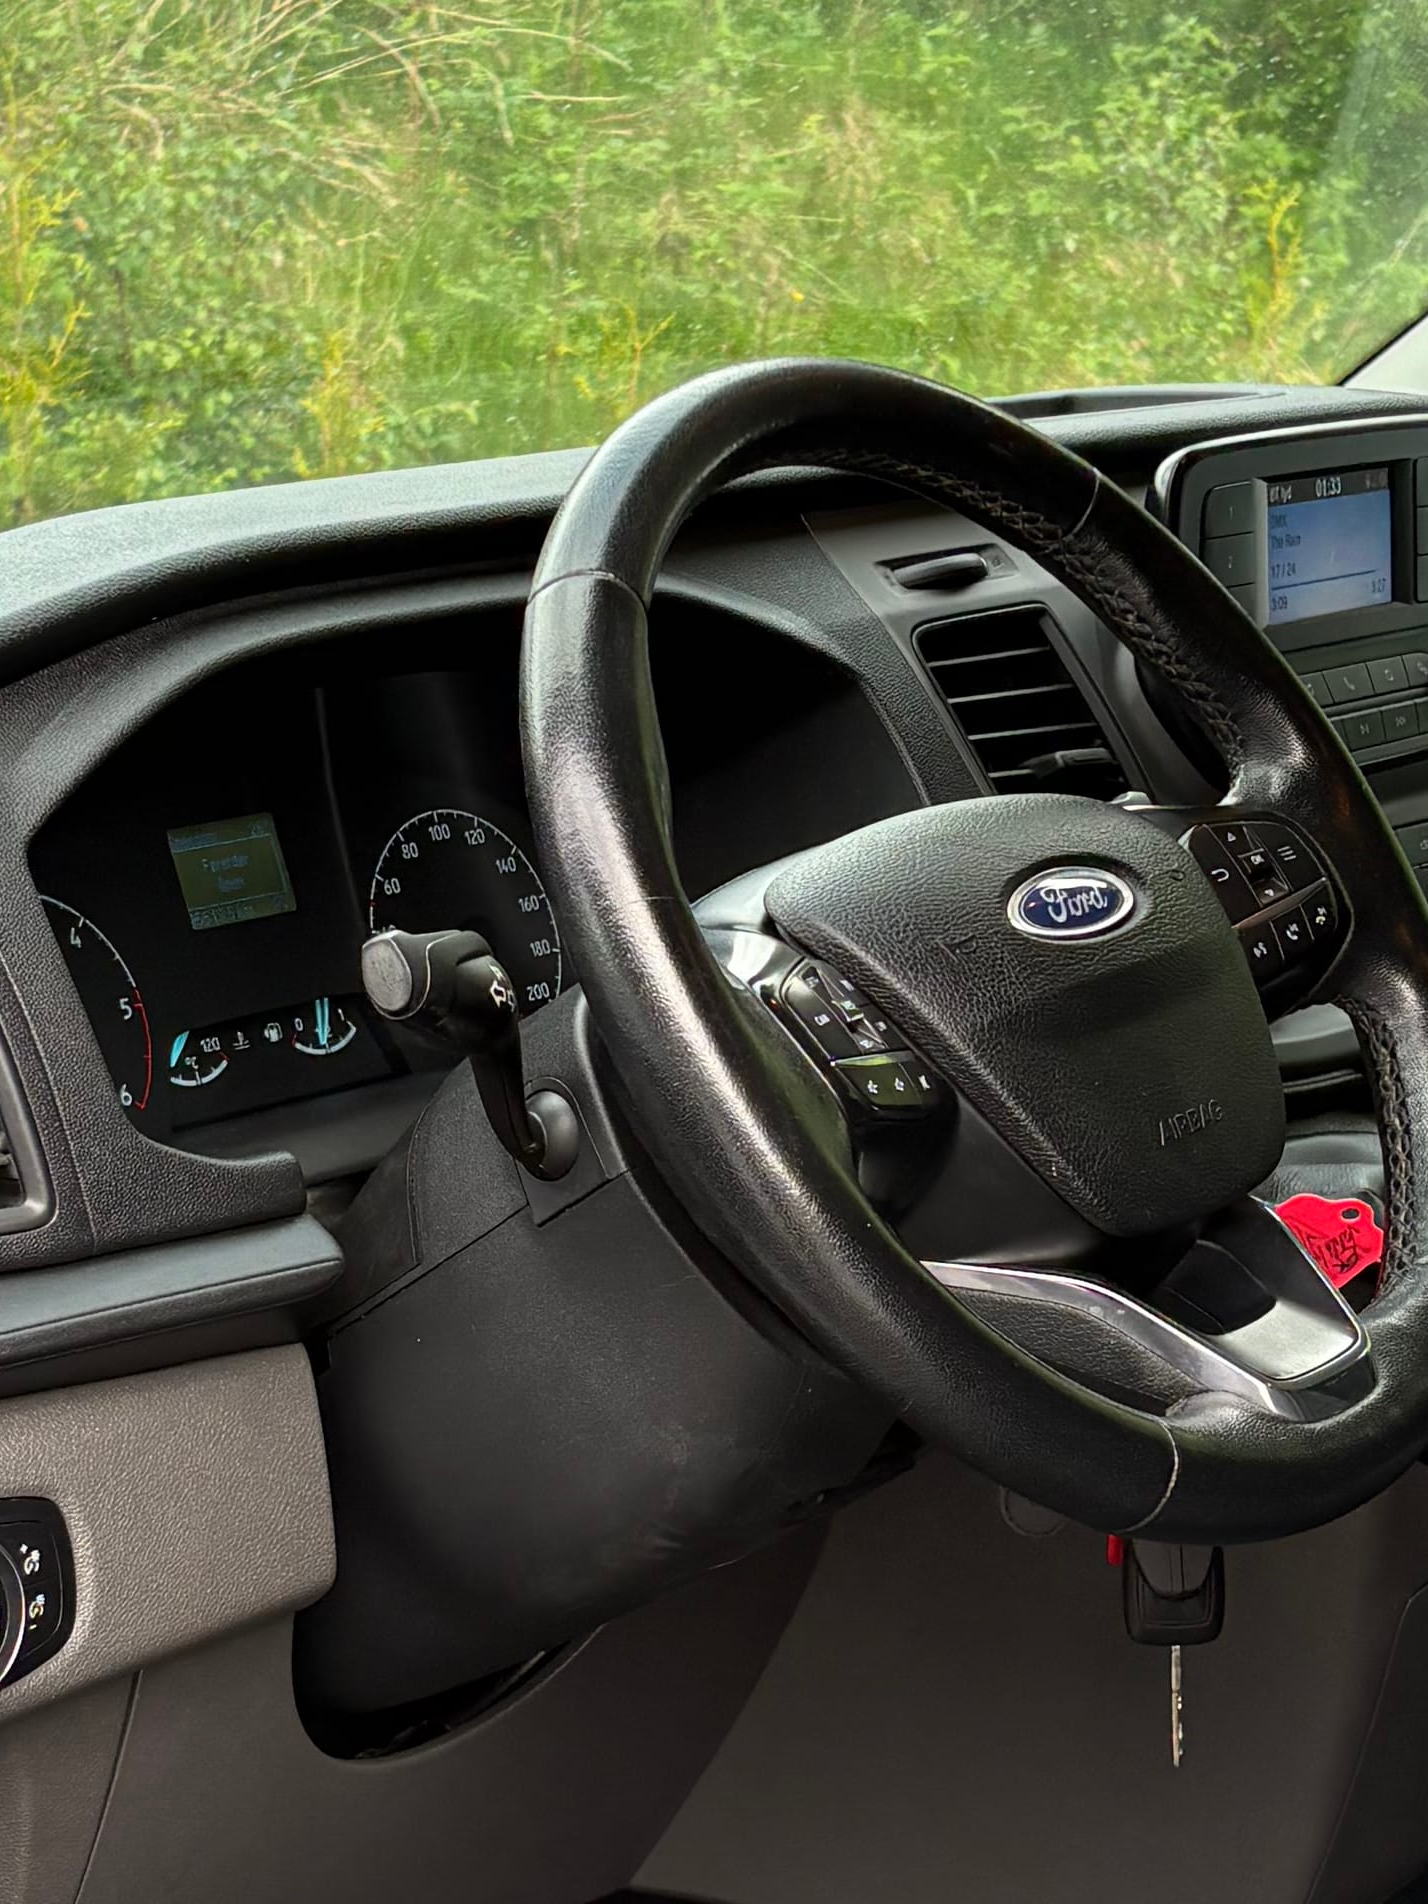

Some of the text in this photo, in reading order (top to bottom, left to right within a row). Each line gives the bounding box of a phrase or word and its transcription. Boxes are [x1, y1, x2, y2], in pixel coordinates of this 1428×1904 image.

[1315, 476, 1342, 498] 01:33
[428, 823, 451, 841] 100
[464, 828, 486, 846] 120
[401, 841, 419, 860] 80
[495, 856, 517, 874] 140
[383, 877, 401, 895] 60
[518, 895, 540, 913] 160
[70, 926, 82, 949] 4
[529, 939, 551, 957] 180
[526, 982, 550, 1002] 200
[119, 998, 133, 1020] 5
[294, 1017, 304, 1032] 0
[200, 1036, 221, 1053] 120
[121, 1083, 133, 1107] 6
[1158, 1098, 1223, 1147] AIRBAG
